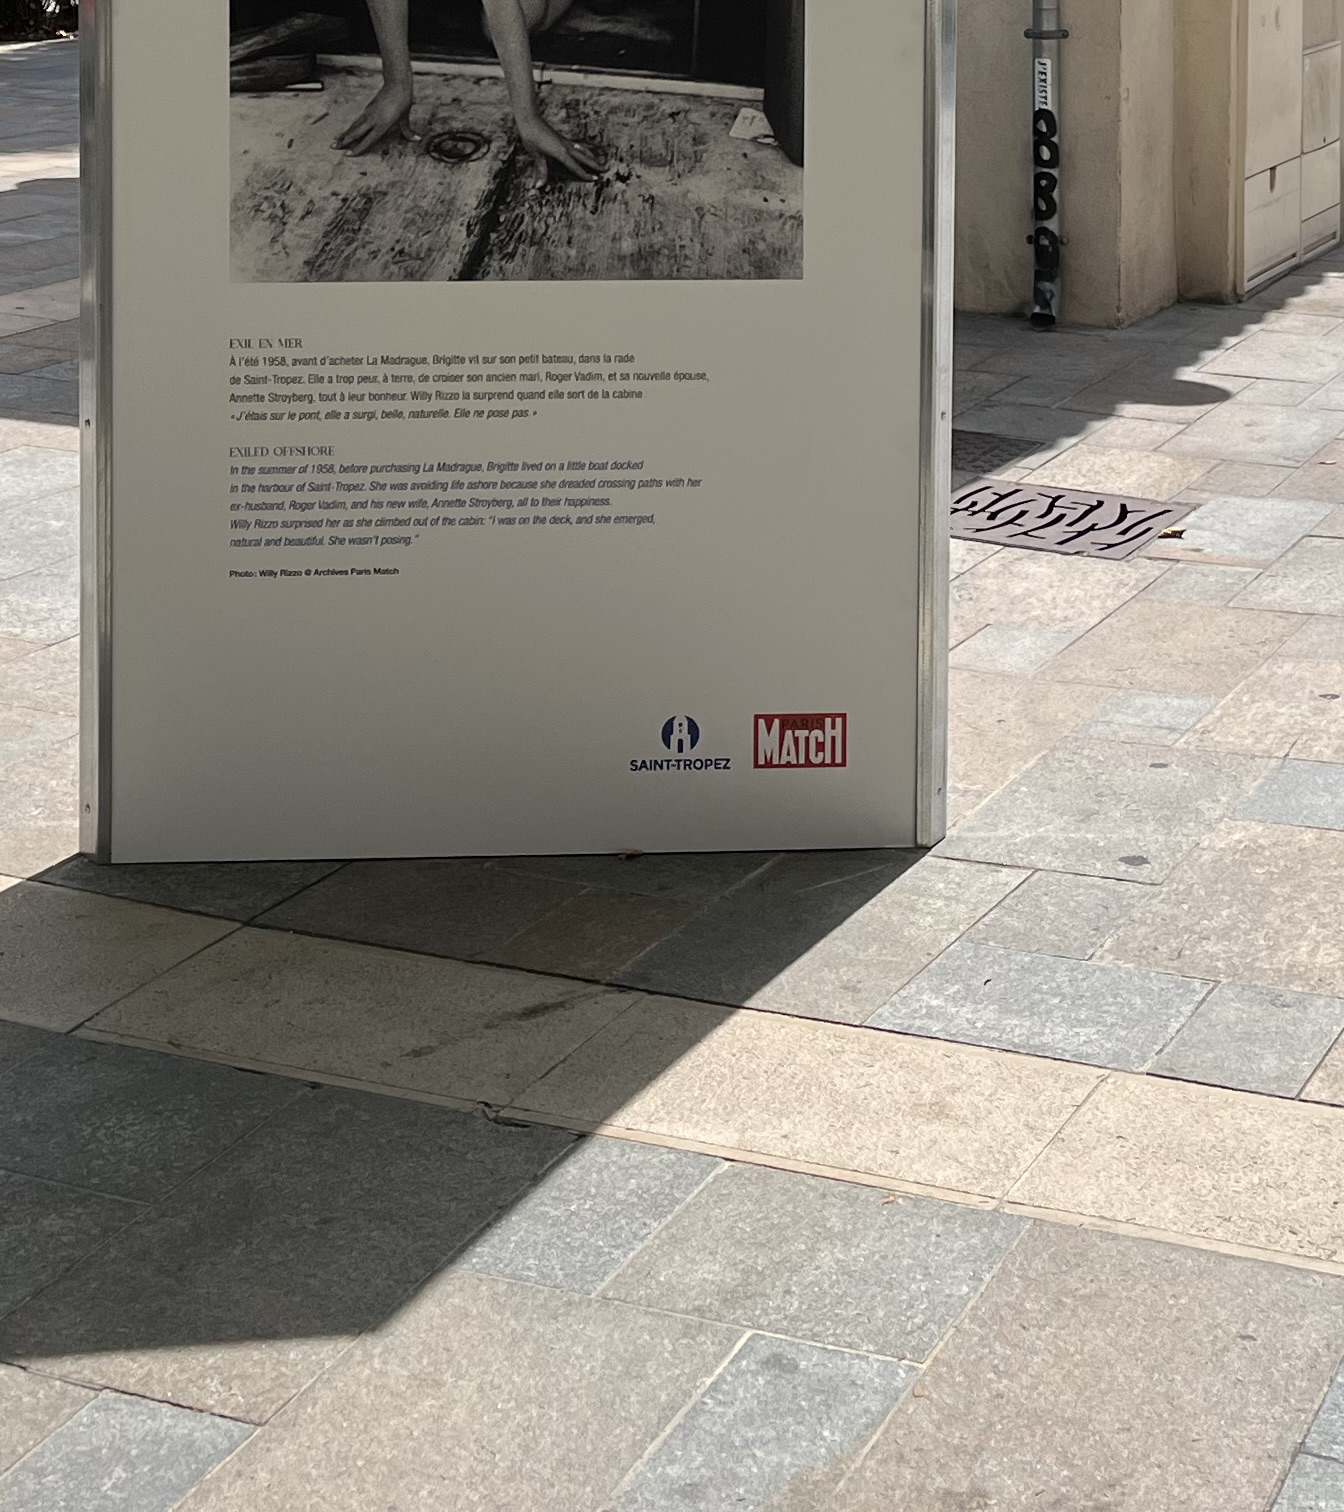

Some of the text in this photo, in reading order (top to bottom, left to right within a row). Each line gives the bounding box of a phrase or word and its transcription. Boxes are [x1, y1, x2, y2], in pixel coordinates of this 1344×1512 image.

[228, 338, 254, 350] EXIL
[278, 338, 304, 348] MER
[228, 352, 636, 368] À l'été 1958, avant d'acheter La Madrague, Brigitte vit sur son petit bateau, dans la rade
[229, 370, 710, 386] de Saint-Tropez. Elle a trop peur, à terre, de croiser son ancien mari, Roger Vadim, et sa nouvelle épouse,
[228, 392, 266, 402] Annette
[267, 392, 316, 404] Stroyberg,
[318, 392, 338, 402] tout
[339, 392, 346, 402] à
[348, 392, 366, 402] leur
[410, 390, 432, 402] Willy
[434, 390, 460, 400] Rizzo
[462, 390, 470, 400] la
[472, 390, 514, 402] surprend
[516, 390, 546, 402] quand
[548, 390, 564, 400] elle
[566, 390, 586, 400] sort
[587, 390, 600, 400] de
[602, 388, 610, 398] la
[229, 446, 334, 458] EXILED OFFSHORE
[229, 460, 644, 476] In the summer of 1958, before purchasing La Madrague, Brigitte lived on a little boat docked
[229, 570, 258, 578] Photo:
[258, 570, 278, 578] Willy
[280, 568, 302, 576] Rizzo
[314, 568, 349, 576] Archives
[350, 568, 372, 576] Paris
[757, 717, 843, 765] MATCH
[629, 757, 731, 772] SAINT-TROPEZ
